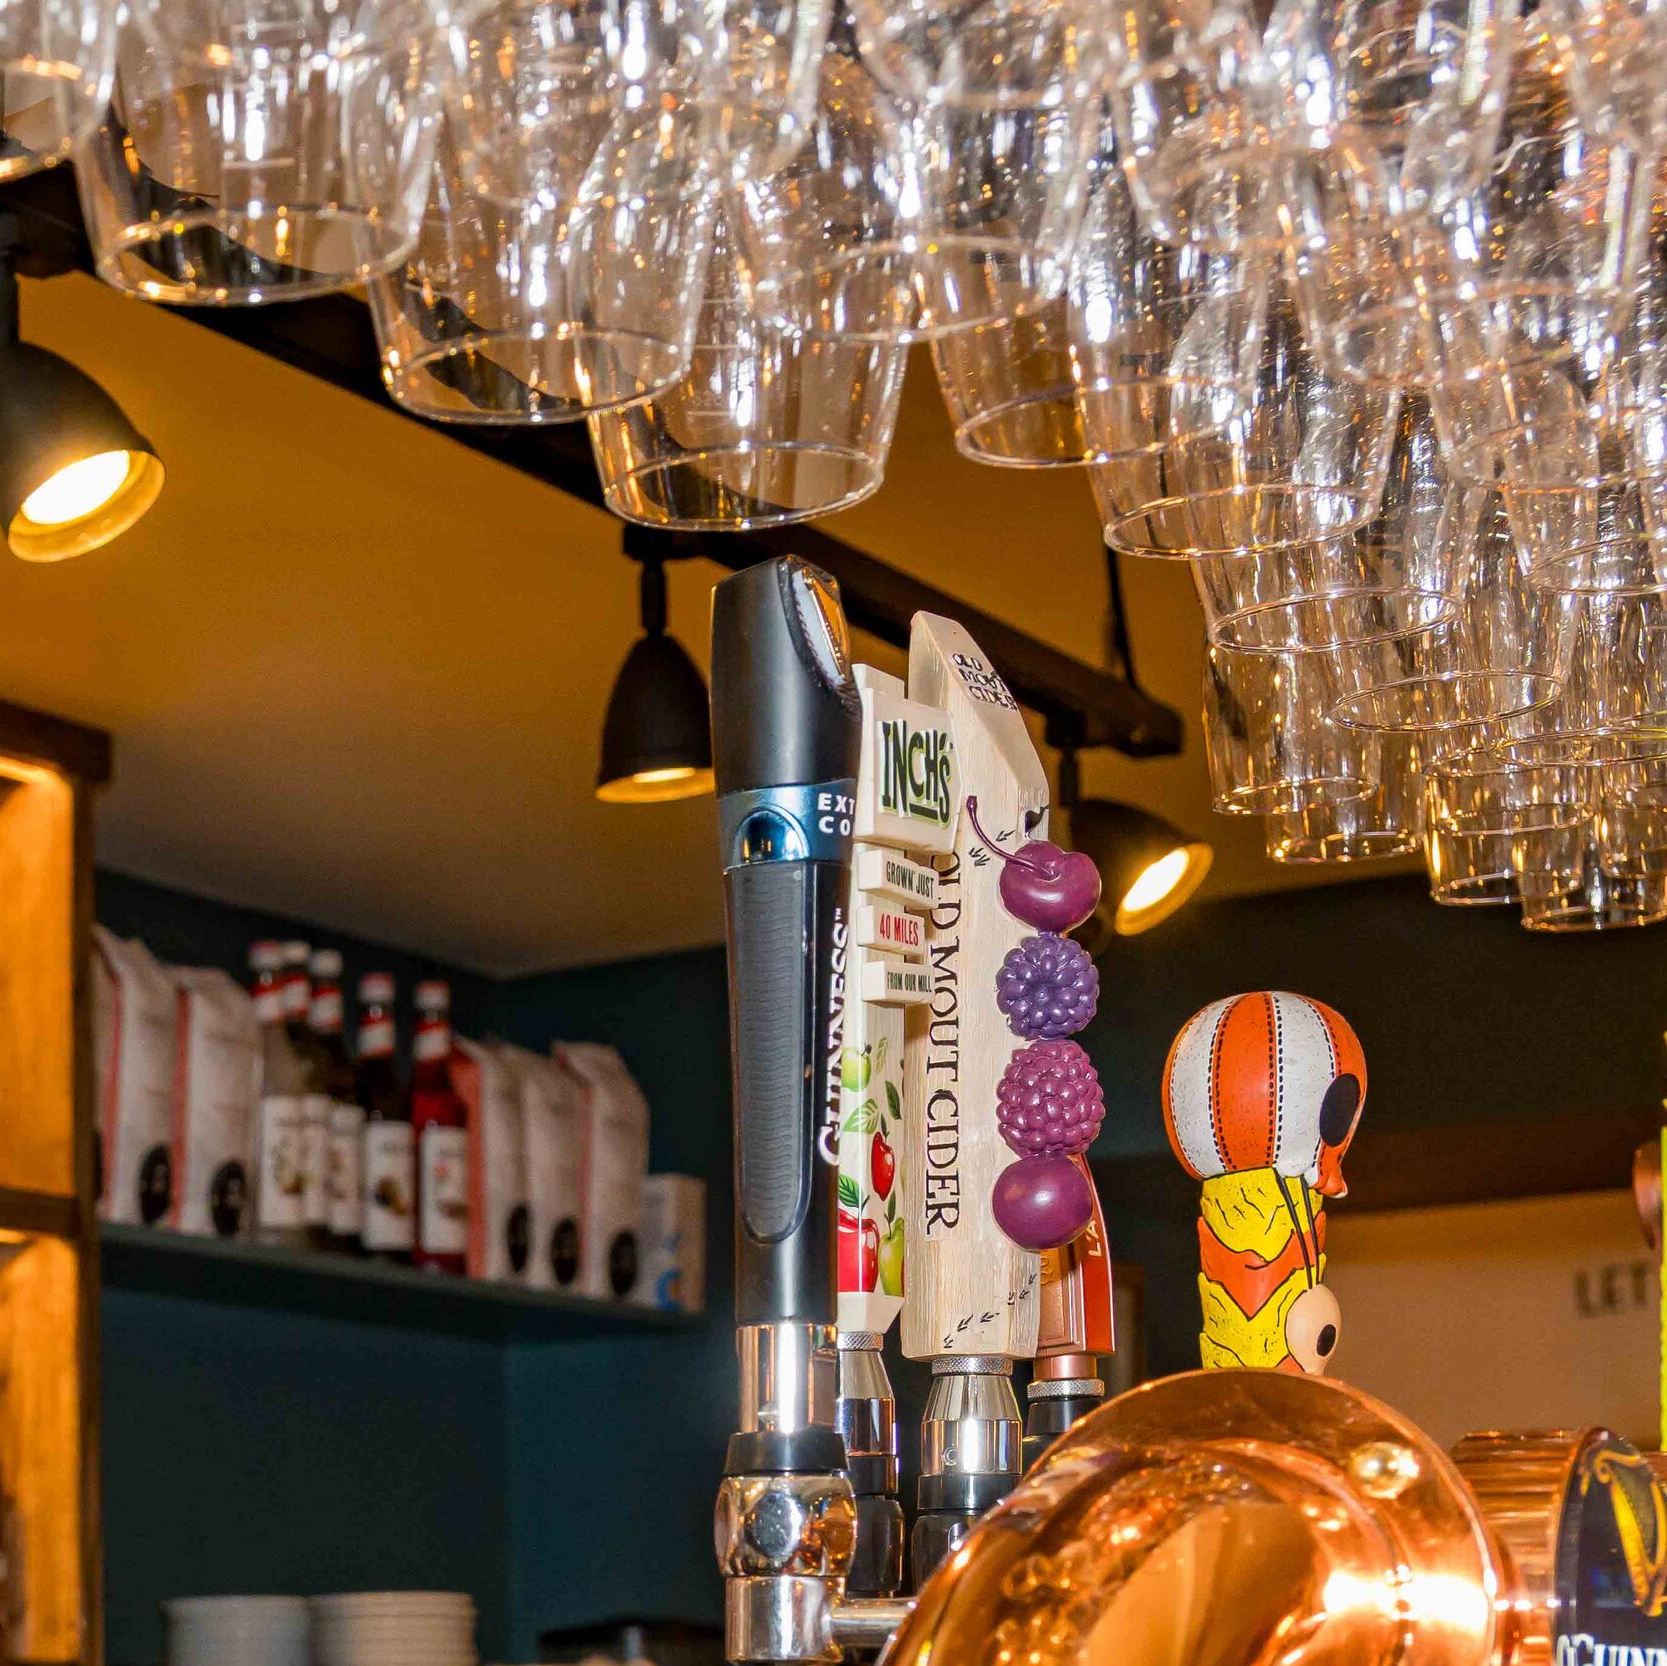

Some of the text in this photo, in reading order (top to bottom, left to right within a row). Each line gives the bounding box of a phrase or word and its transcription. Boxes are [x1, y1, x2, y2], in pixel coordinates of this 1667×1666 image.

[879, 913, 919, 947] 40 MILES
[886, 970, 932, 993] FROM OUR MILL
[926, 936, 961, 1084] MOUT
[925, 1087, 961, 1236] CIDER
